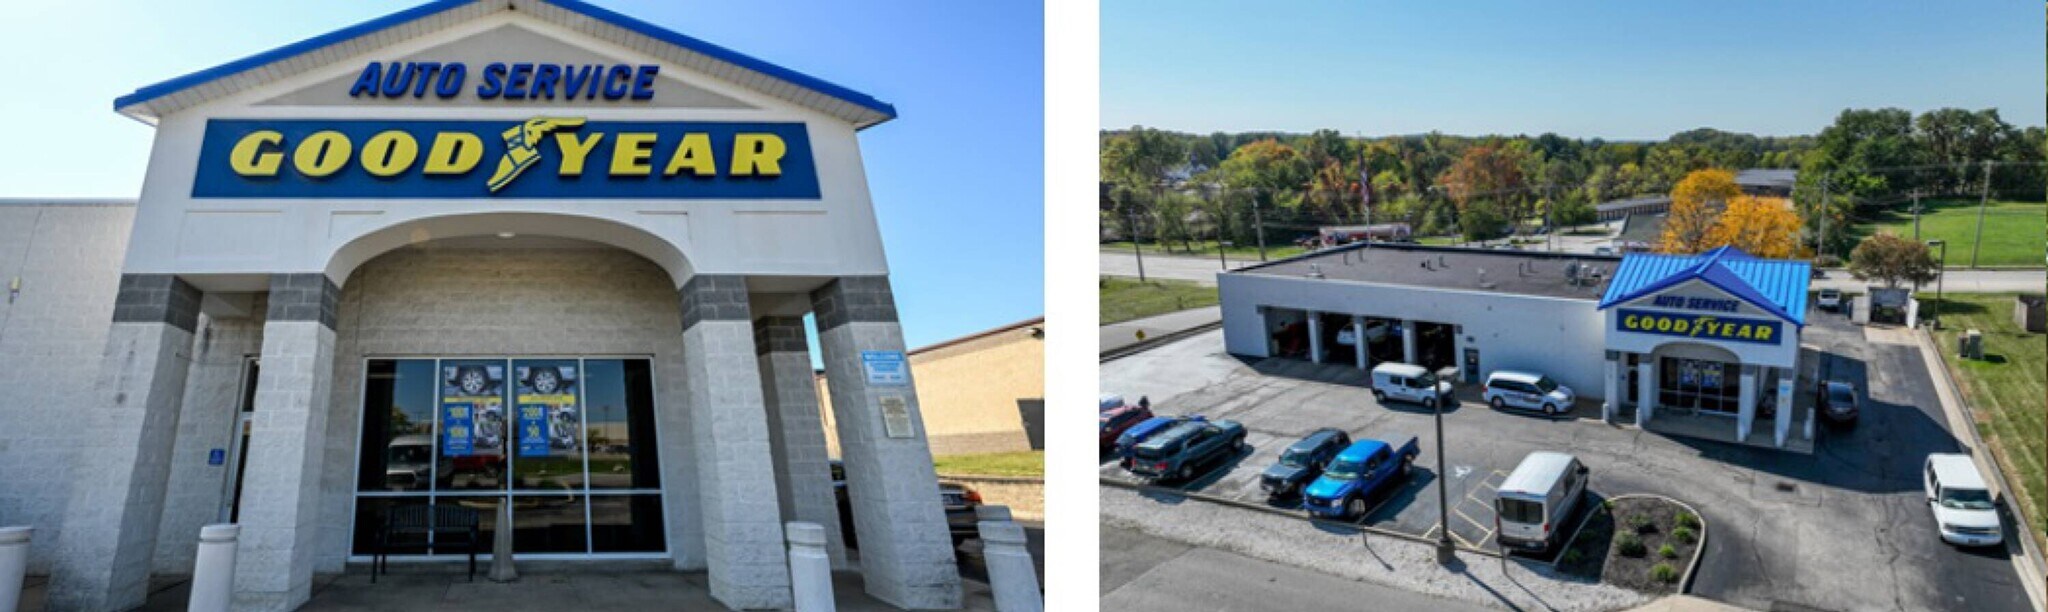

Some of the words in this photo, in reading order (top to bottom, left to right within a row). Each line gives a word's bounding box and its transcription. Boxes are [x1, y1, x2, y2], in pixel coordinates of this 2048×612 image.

[351, 62, 465, 99] AUTO
[477, 63, 659, 100] SERVICE
[1653, 295, 1686, 308] AUTO
[1688, 297, 1740, 312] SERVICE
